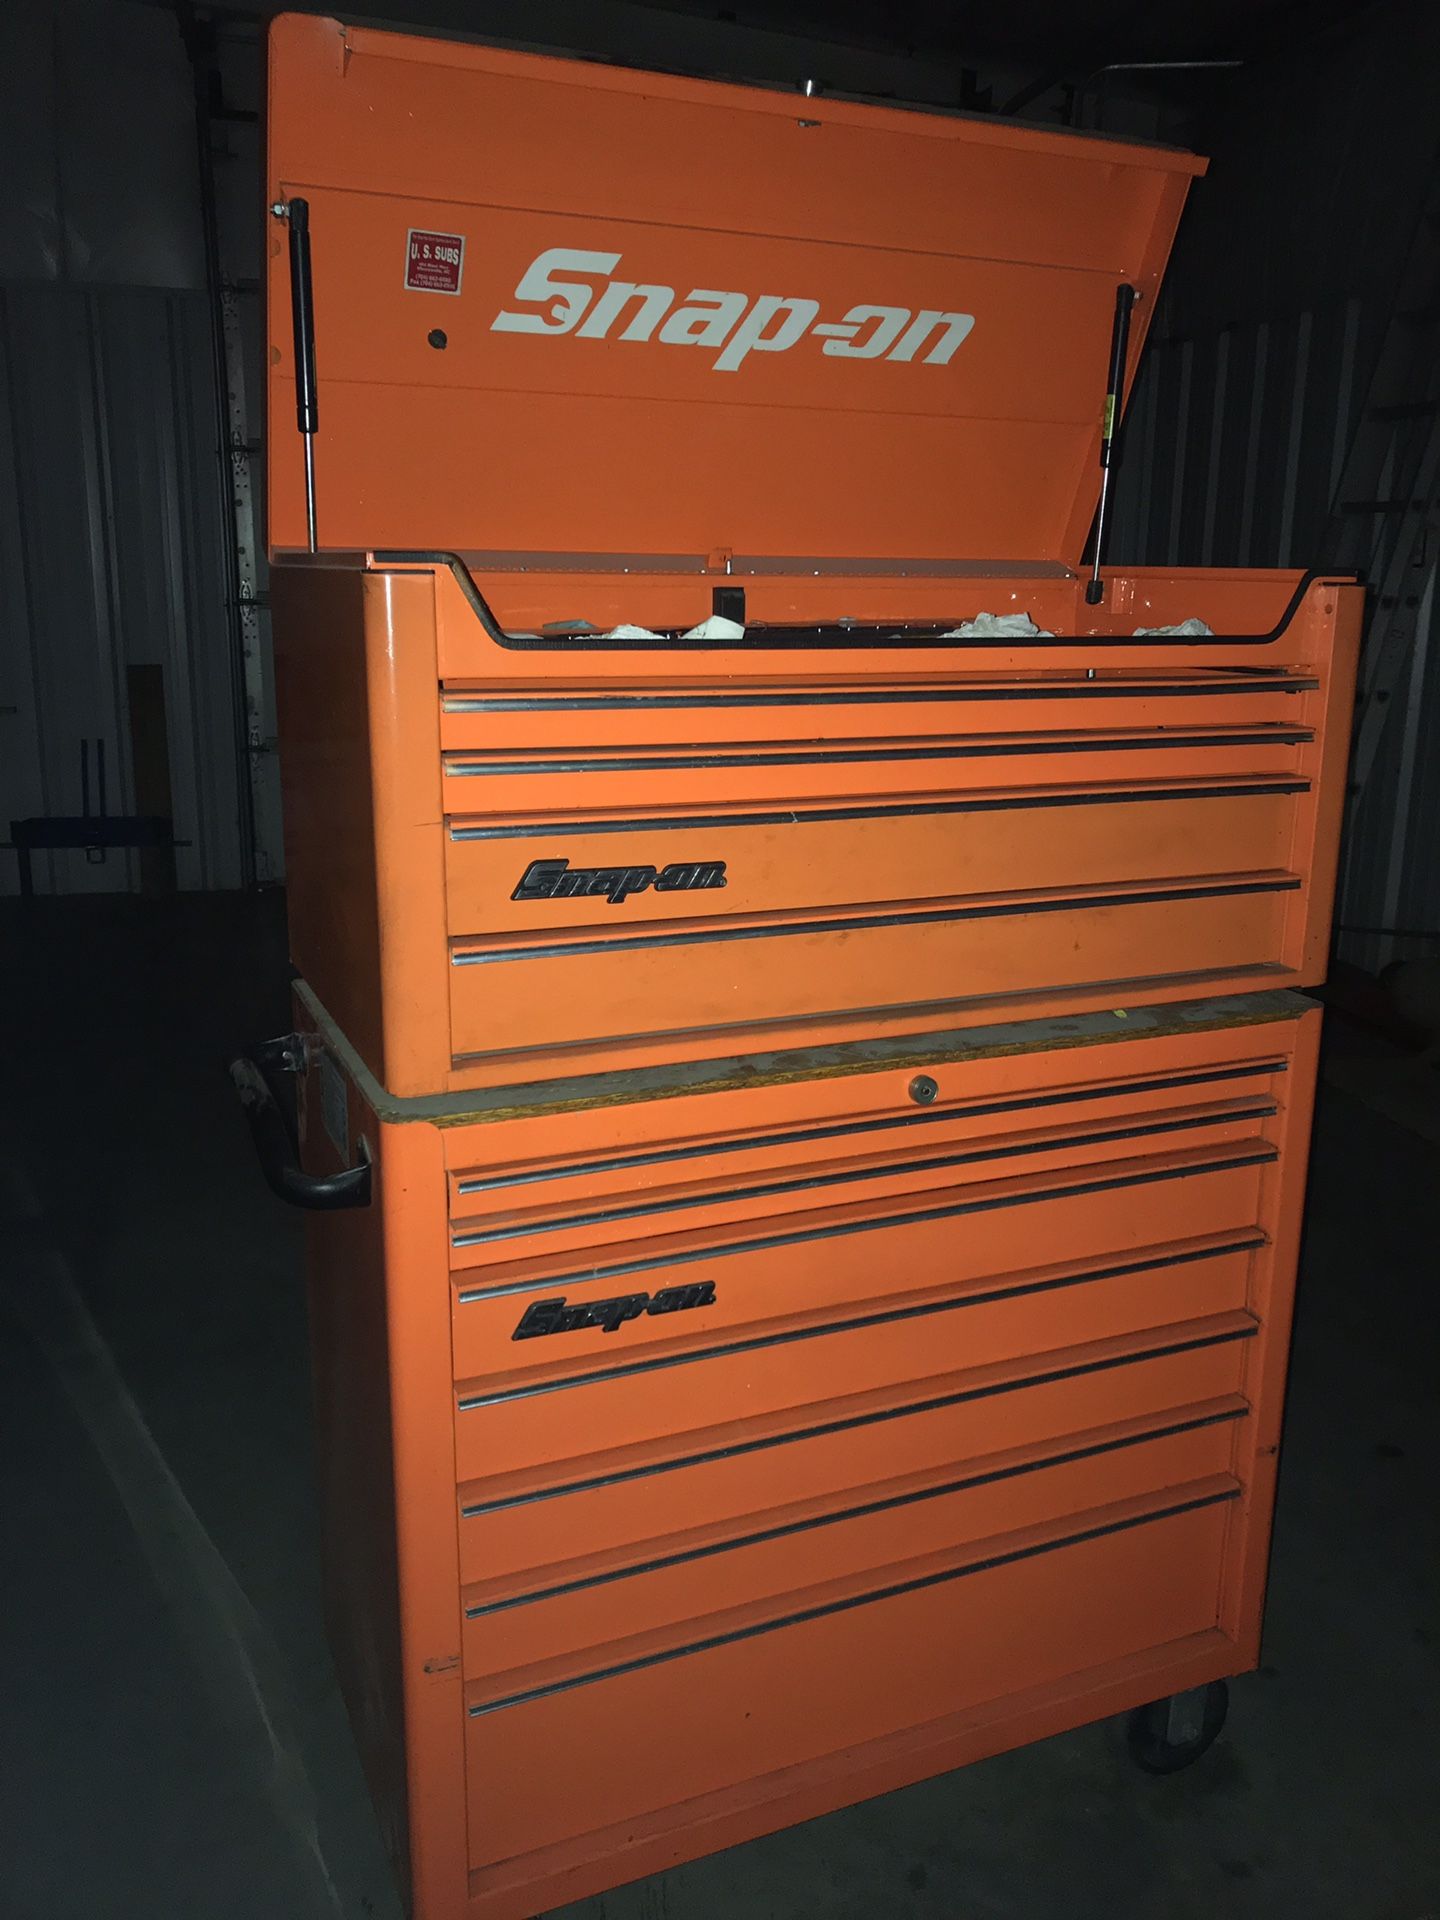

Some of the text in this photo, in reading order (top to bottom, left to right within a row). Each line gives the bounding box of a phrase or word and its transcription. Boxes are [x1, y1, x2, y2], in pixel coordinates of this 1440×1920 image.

[434, 245, 460, 266] SUBS
[489, 247, 975, 371] Snap-on
[511, 859, 727, 904] Snap-on
[512, 1280, 717, 1342] Snap-on
